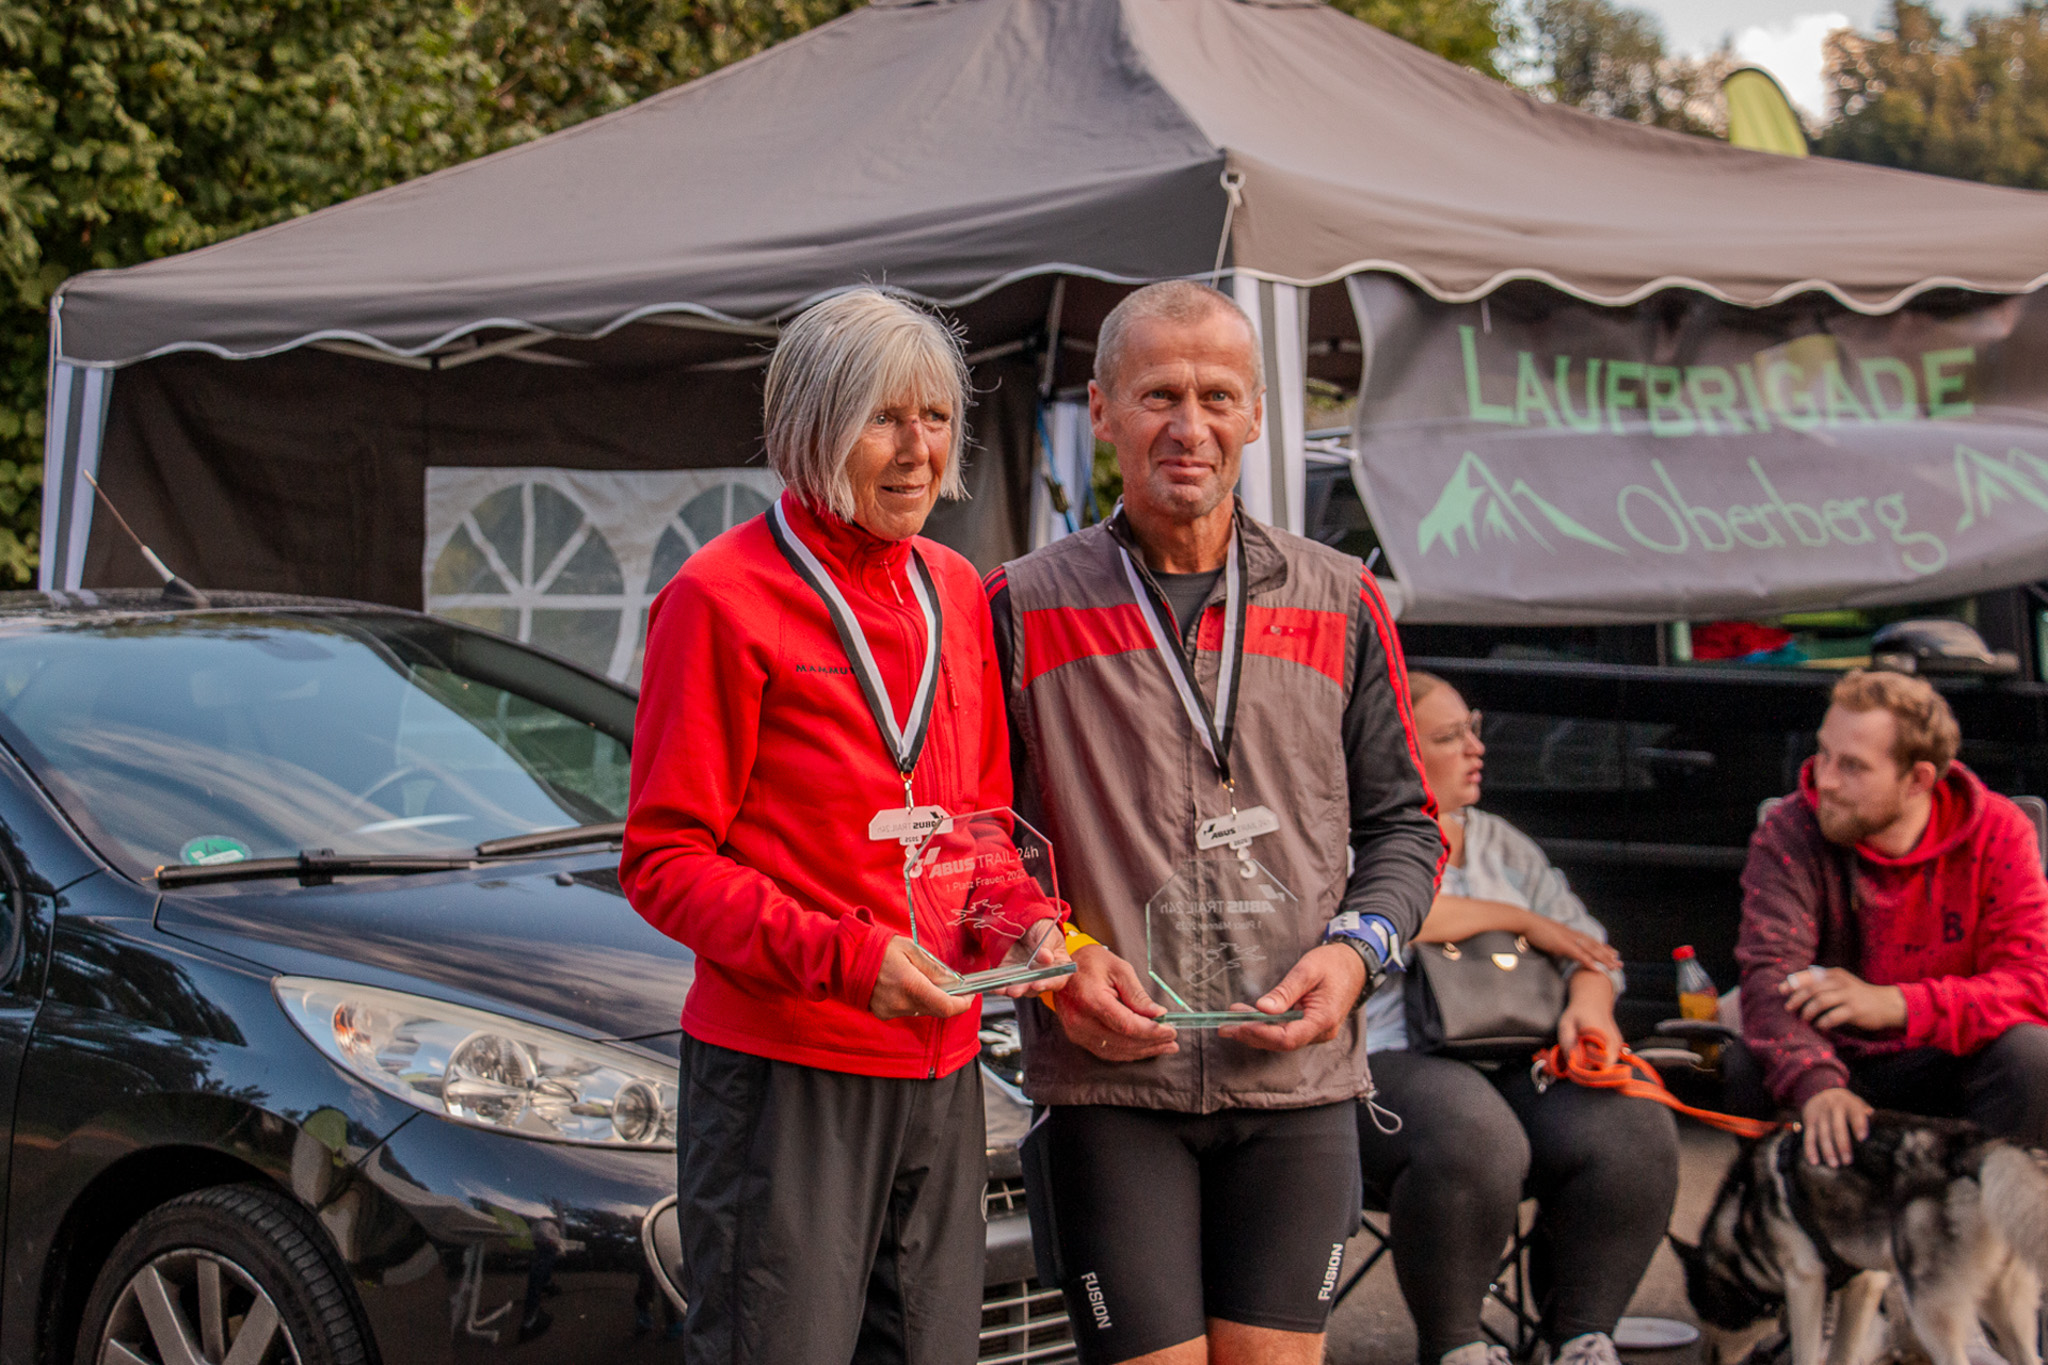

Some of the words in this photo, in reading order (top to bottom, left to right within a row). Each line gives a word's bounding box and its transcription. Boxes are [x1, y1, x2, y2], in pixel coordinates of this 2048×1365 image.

[1458, 325, 1975, 437] LAUFBRIGADE
[1616, 456, 1948, 574] Oberberg
[928, 857, 976, 879] ABUS
[976, 850, 1015, 868] TRAIL
[1016, 845, 1040, 861] 24h
[1210, 827, 1236, 840] ABUS
[975, 875, 1005, 888] Frauen
[1081, 1271, 1112, 1329] FUSION
[1317, 1243, 1344, 1301] FUSION
